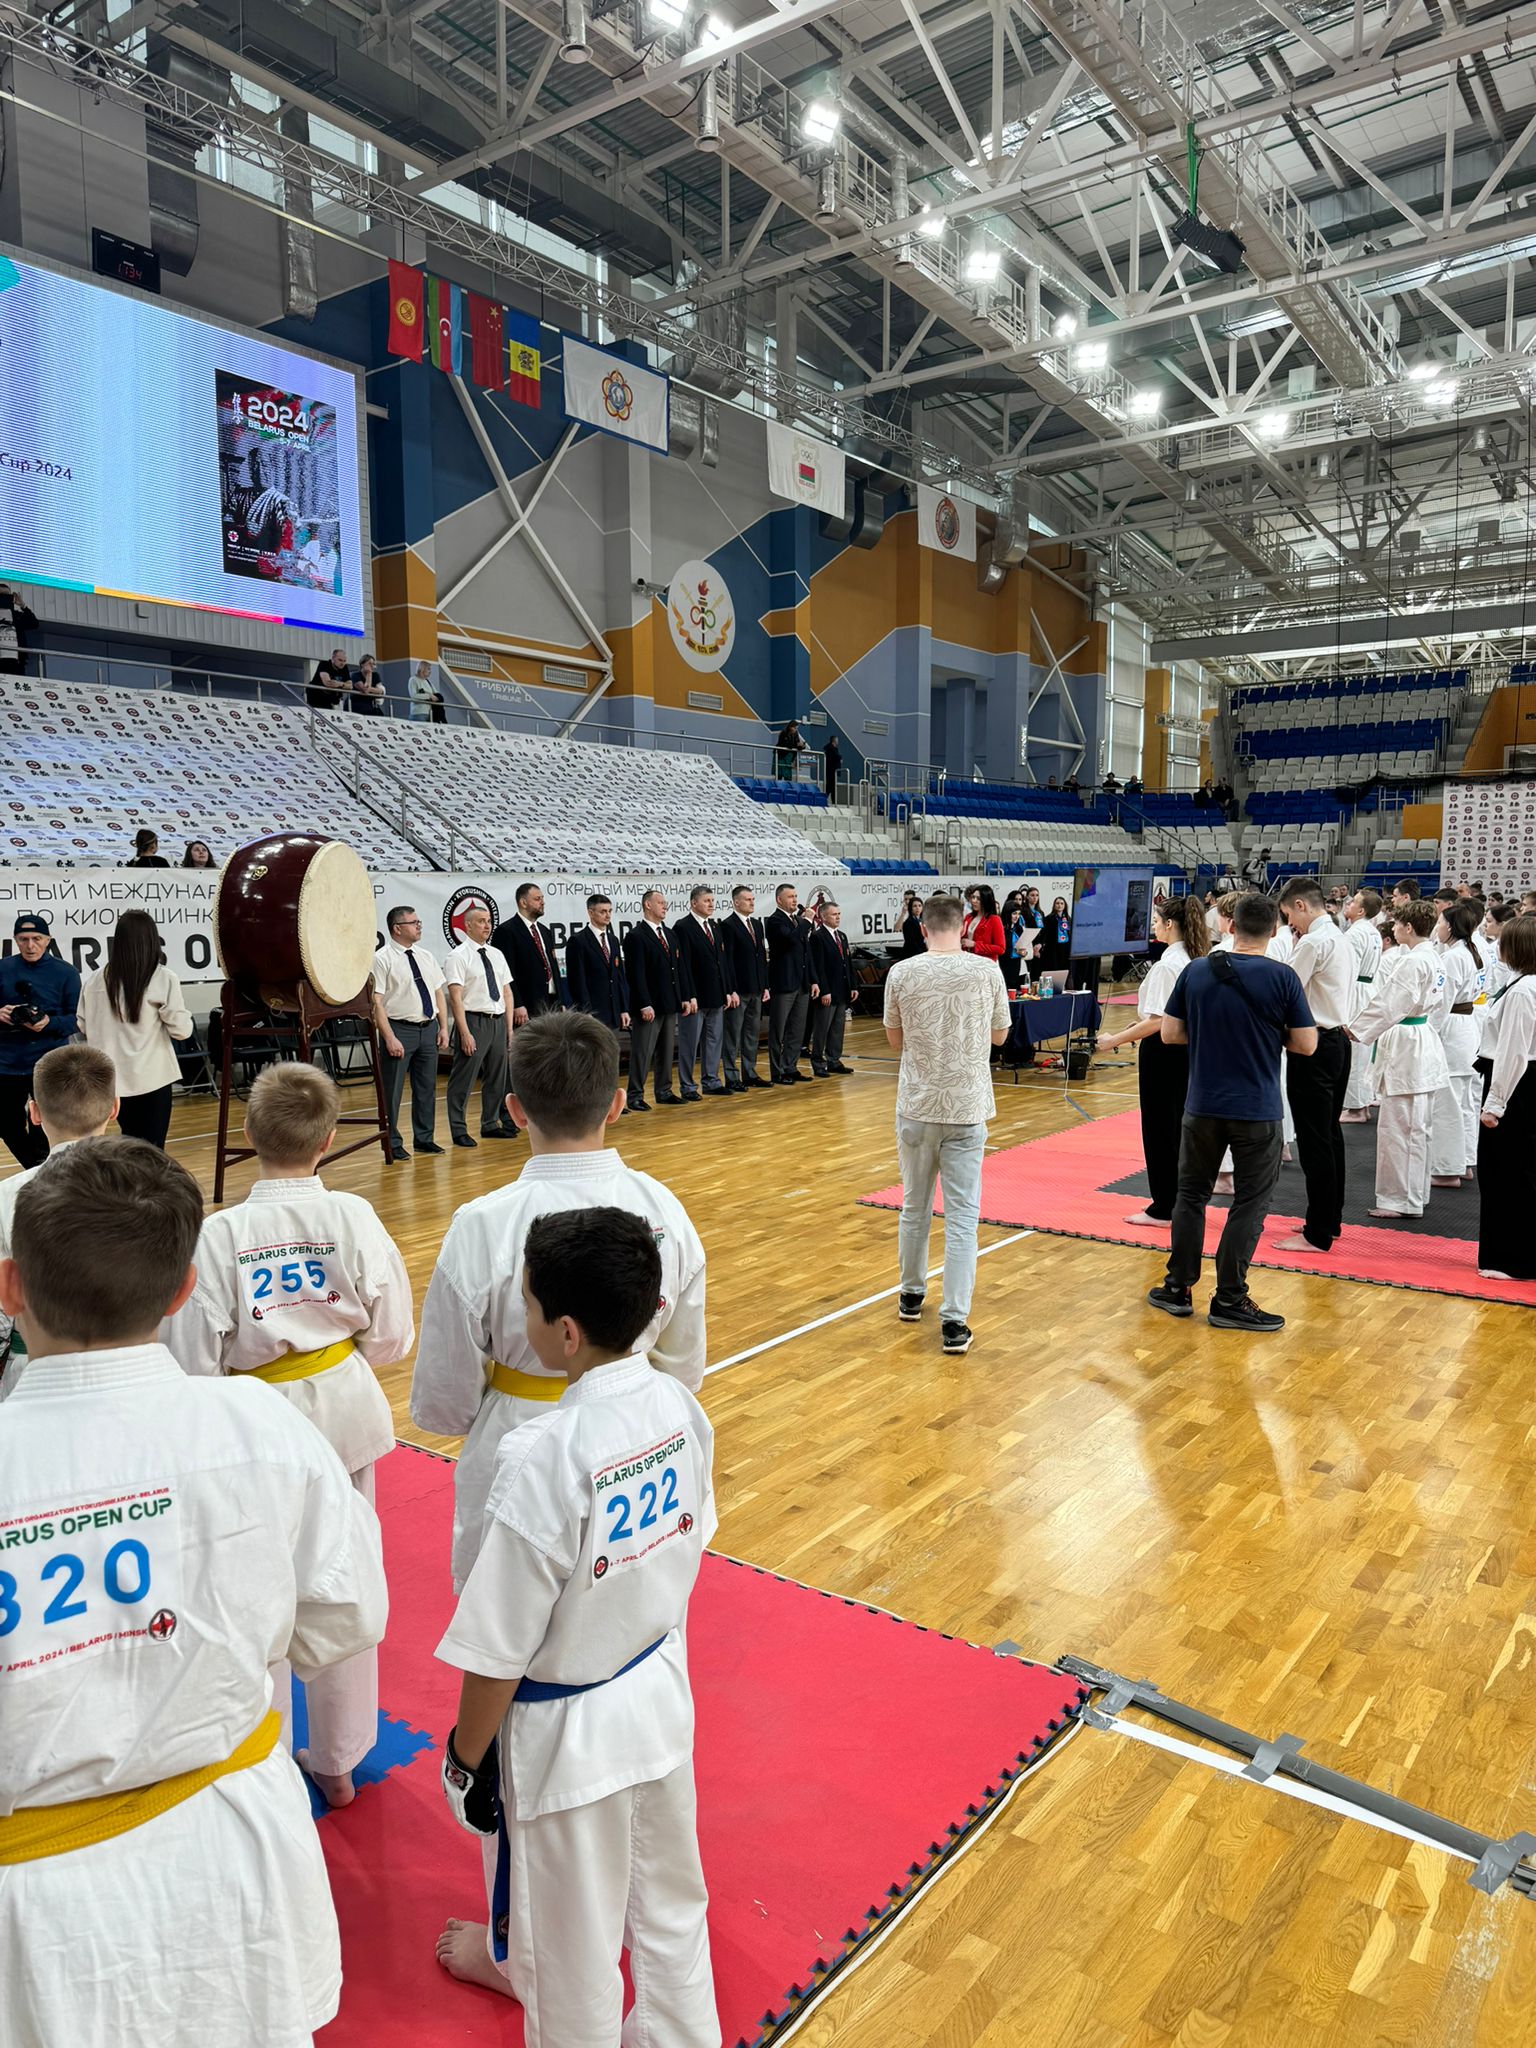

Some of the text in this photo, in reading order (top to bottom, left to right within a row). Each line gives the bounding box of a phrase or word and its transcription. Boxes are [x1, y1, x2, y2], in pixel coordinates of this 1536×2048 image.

[248, 396, 308, 431] 2024
[248, 421, 285, 437] BELARUS
[0, 453, 72, 480] Cup 2024
[474, 680, 521, 694] ТРИБУНА
[455, 888, 488, 899] KYOKUSHIN
[546, 881, 622, 896] ОТКРЫТЫЙ
[626, 881, 733, 896] МЕЖДУНАРНЫЙ
[239, 1248, 286, 1264] BELARUS
[289, 1246, 312, 1256] OPEN
[314, 1246, 335, 1256] CUP
[252, 1260, 326, 1299] 255
[595, 1462, 644, 1494] BELARUS
[667, 1438, 686, 1457] CUP
[140, 1487, 170, 1499] BELARUS
[606, 1467, 679, 1543] 222
[61, 1507, 123, 1535] OPEN
[128, 1497, 172, 1521] CUP
[7, 1659, 37, 1672] APRIL
[39, 1649, 63, 1663] 2024
[70, 1633, 113, 1652] BELARUS
[119, 1628, 148, 1639] MINSK
